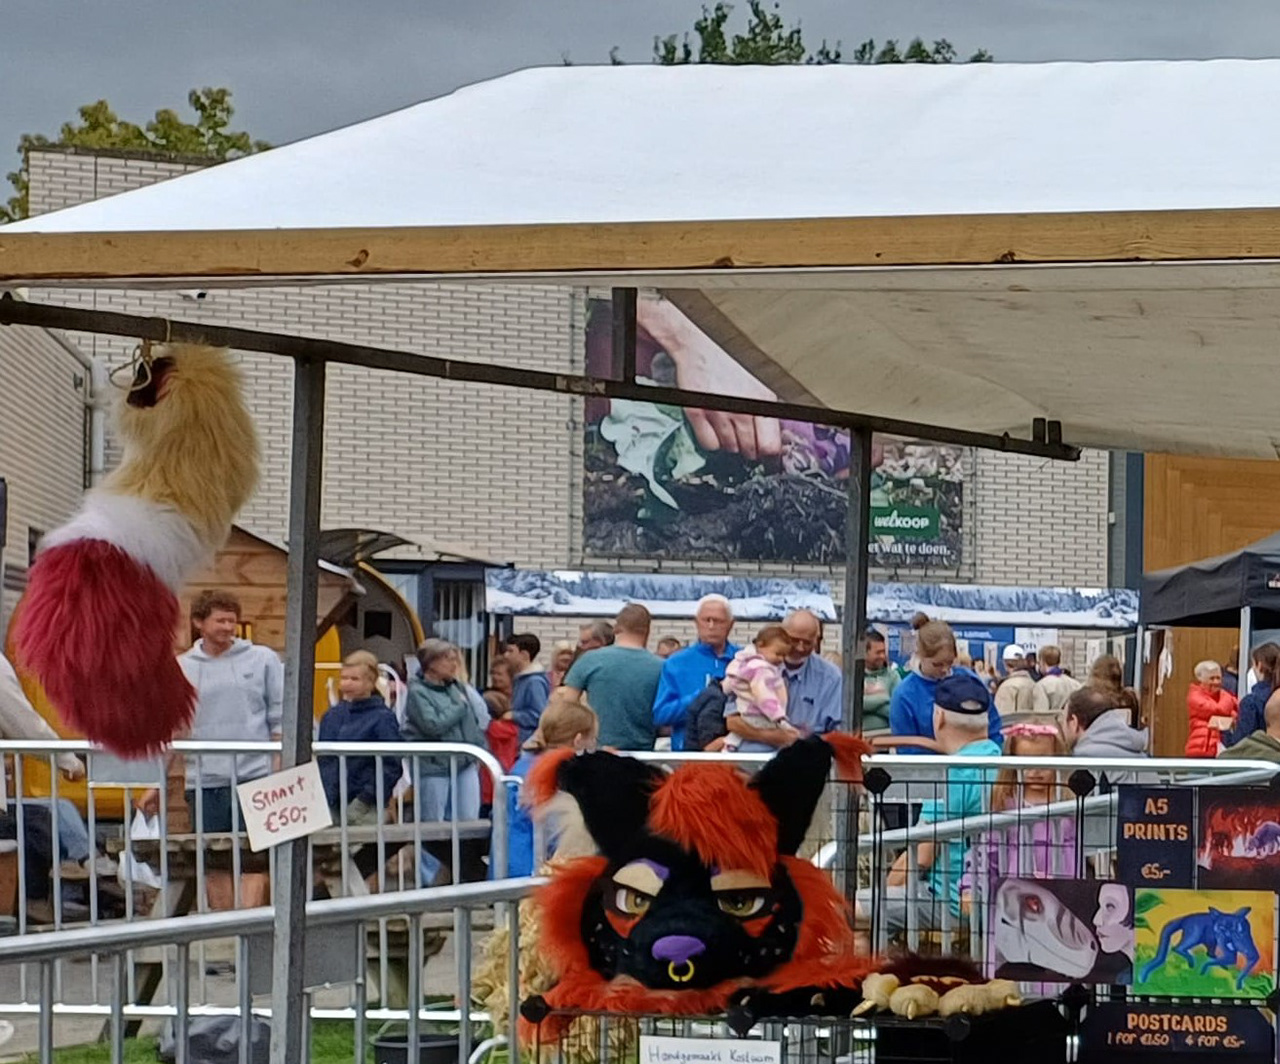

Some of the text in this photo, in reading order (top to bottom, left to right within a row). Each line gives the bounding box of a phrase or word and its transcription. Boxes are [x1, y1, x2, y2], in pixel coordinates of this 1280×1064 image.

[905, 543, 917, 555] te
[1144, 797, 1169, 816] A5
[1122, 822, 1189, 841] PRINTS
[1126, 1013, 1229, 1033] POSTCARDS
